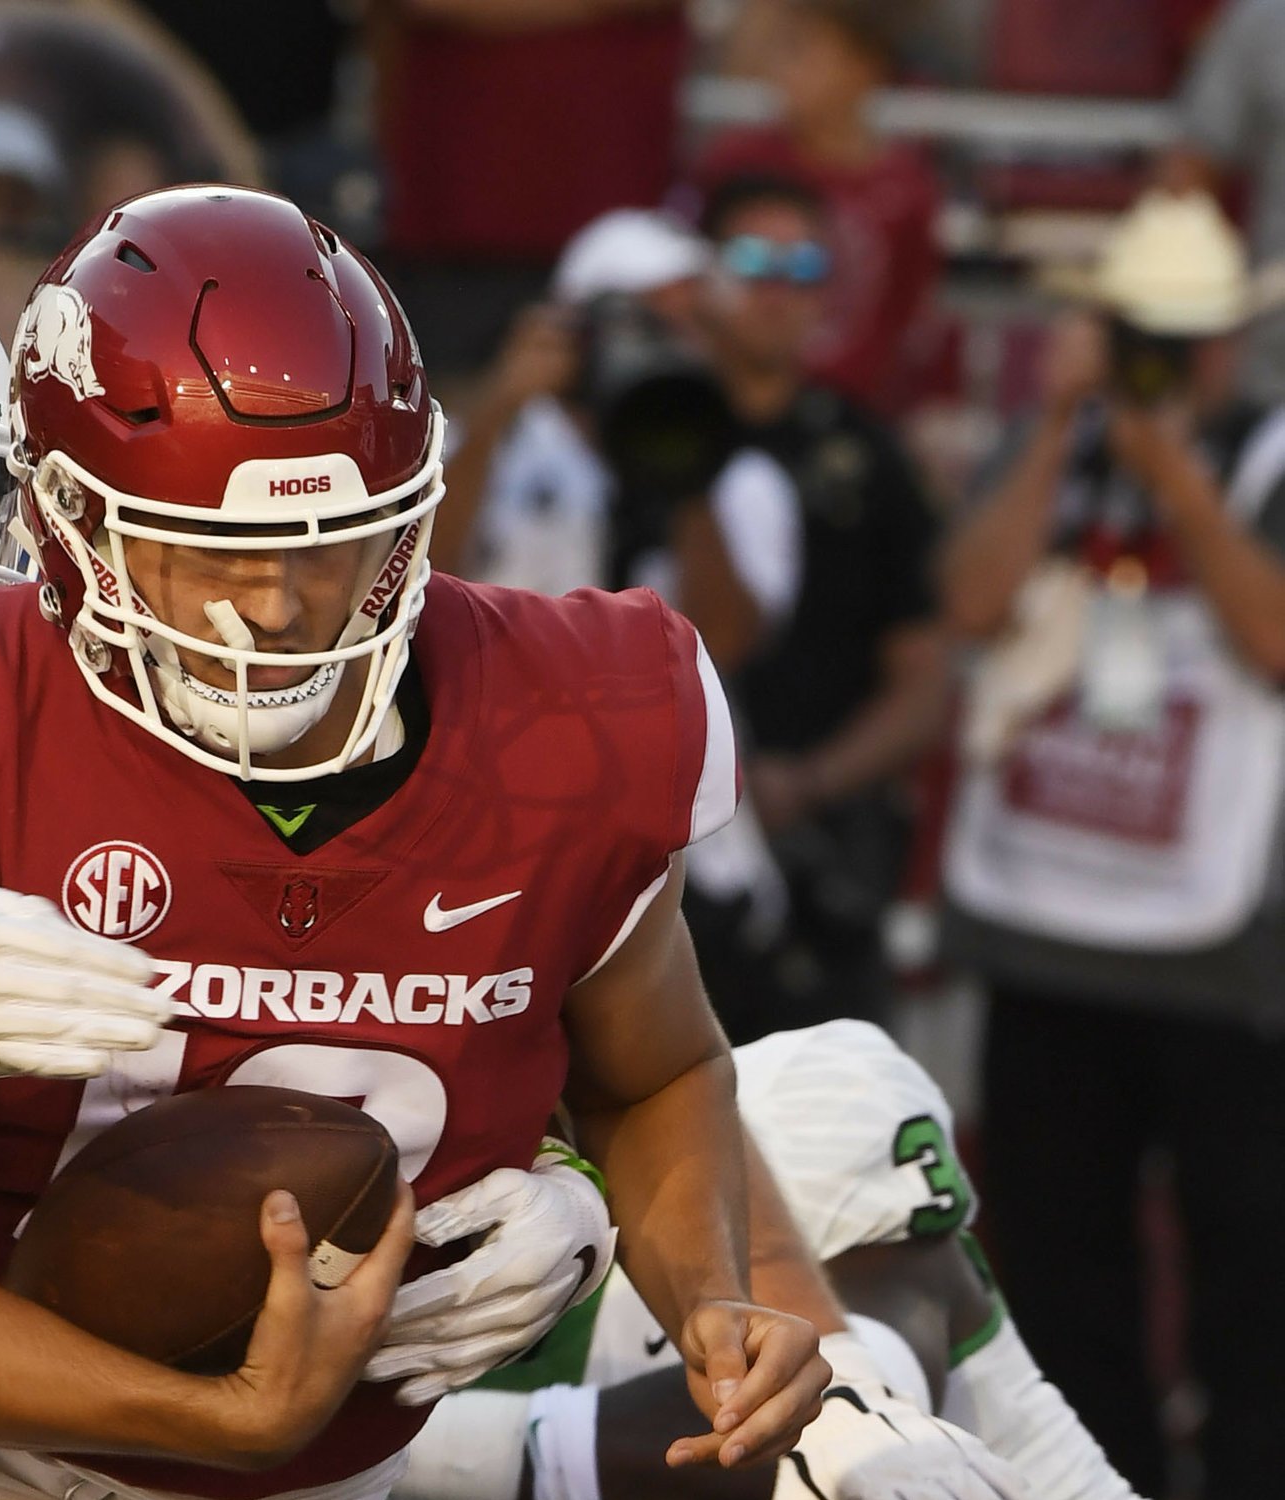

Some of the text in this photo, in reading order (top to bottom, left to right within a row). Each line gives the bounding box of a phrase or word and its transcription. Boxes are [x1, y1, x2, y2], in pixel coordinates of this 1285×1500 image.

[269, 475, 331, 497] HOGS
[75, 850, 160, 935] SEC
[141, 958, 534, 1025] ZORBACKS
[893, 1114, 967, 1236] 3
